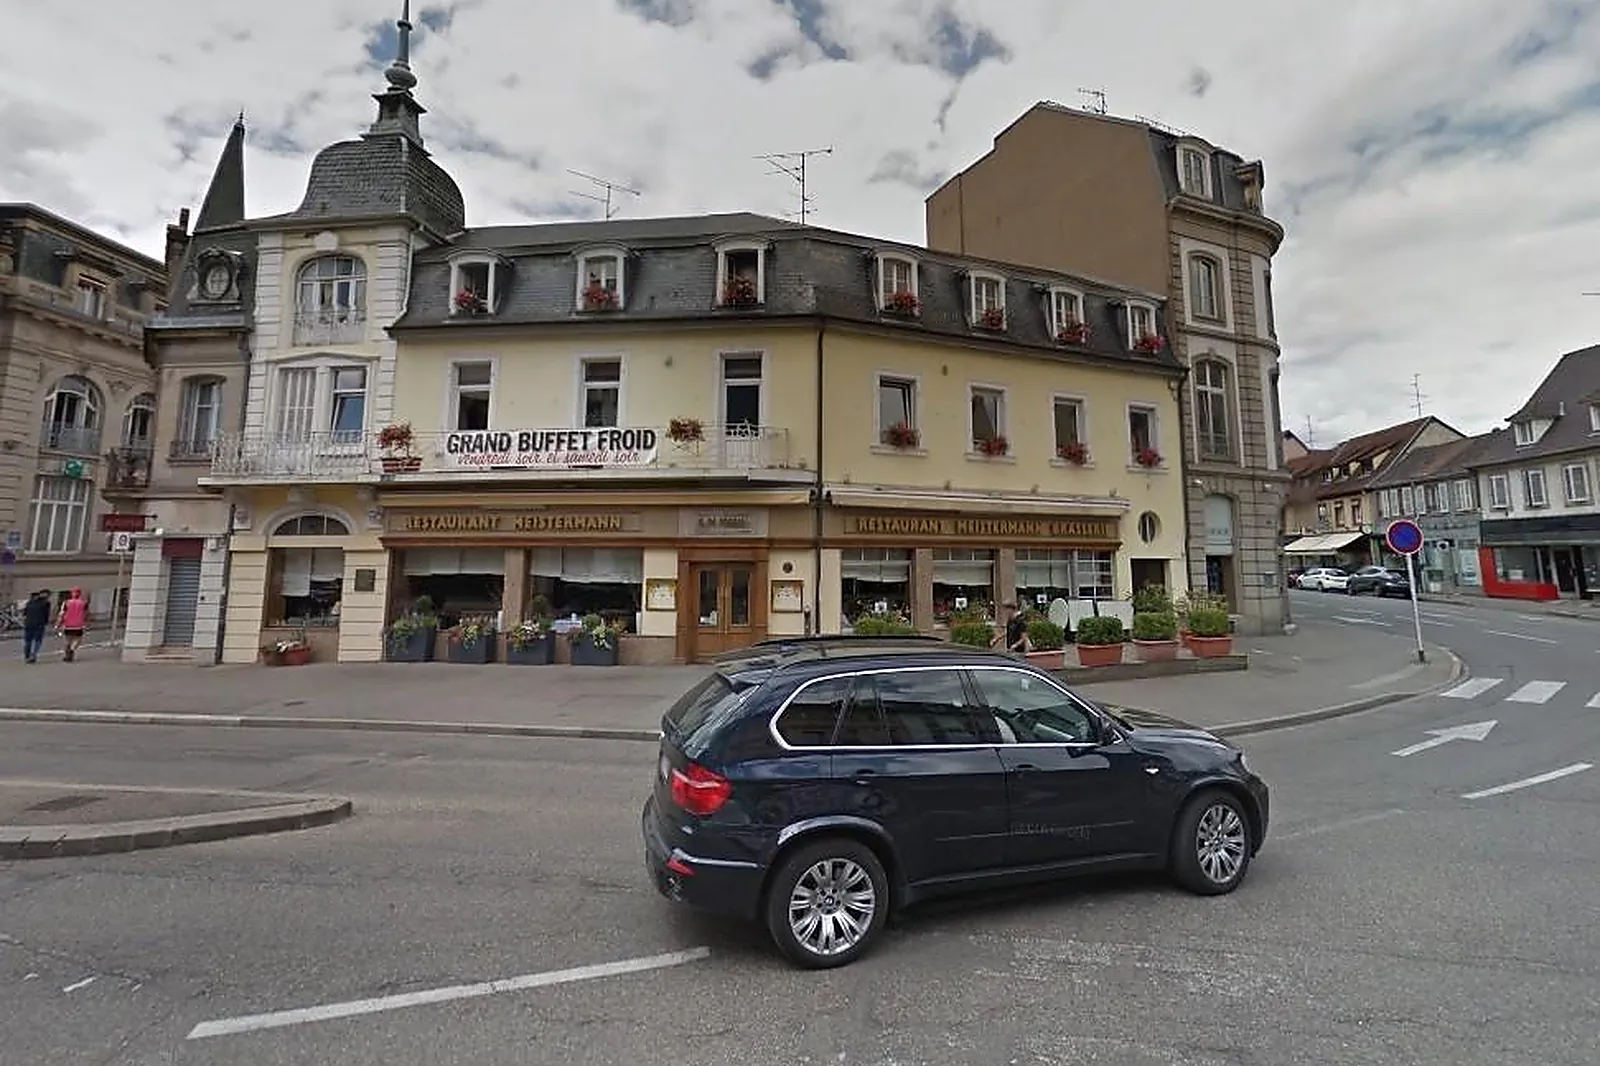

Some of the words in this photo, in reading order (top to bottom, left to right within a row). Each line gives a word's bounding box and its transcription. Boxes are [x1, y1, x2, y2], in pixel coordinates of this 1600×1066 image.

[447, 432, 511, 455] GRAND
[518, 431, 592, 452] BUFFET
[598, 429, 656, 451] FROID
